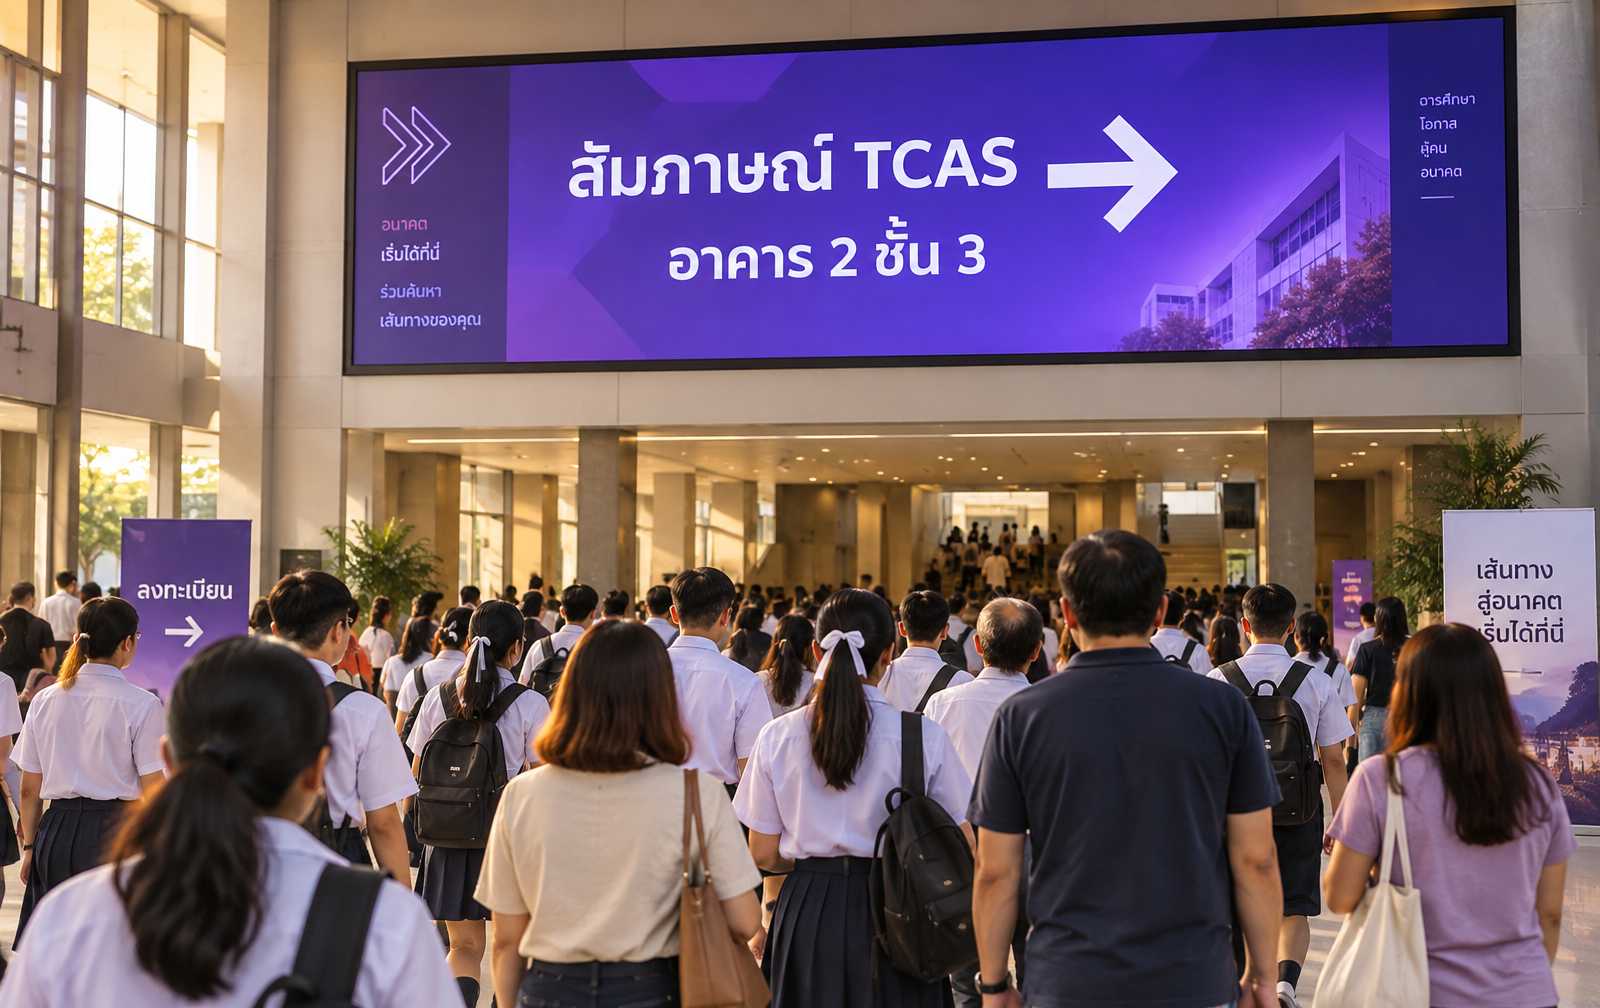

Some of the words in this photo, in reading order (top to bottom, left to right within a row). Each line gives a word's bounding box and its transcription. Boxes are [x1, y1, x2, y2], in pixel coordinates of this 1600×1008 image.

[568, 132, 834, 199] สัมภาษณ์
[853, 136, 1018, 190] TCAS
[381, 218, 428, 232] อนาคต
[668, 244, 814, 281] อาคาร
[829, 236, 858, 278] 2
[875, 215, 940, 277] ชั้น
[957, 233, 986, 275] 3
[379, 311, 482, 331] เส้นทางของคุณ
[1477, 557, 1554, 580] เส้นทาง
[137, 577, 233, 600] ลงทะเบียน
[1477, 588, 1562, 616] สู่อนาคต
